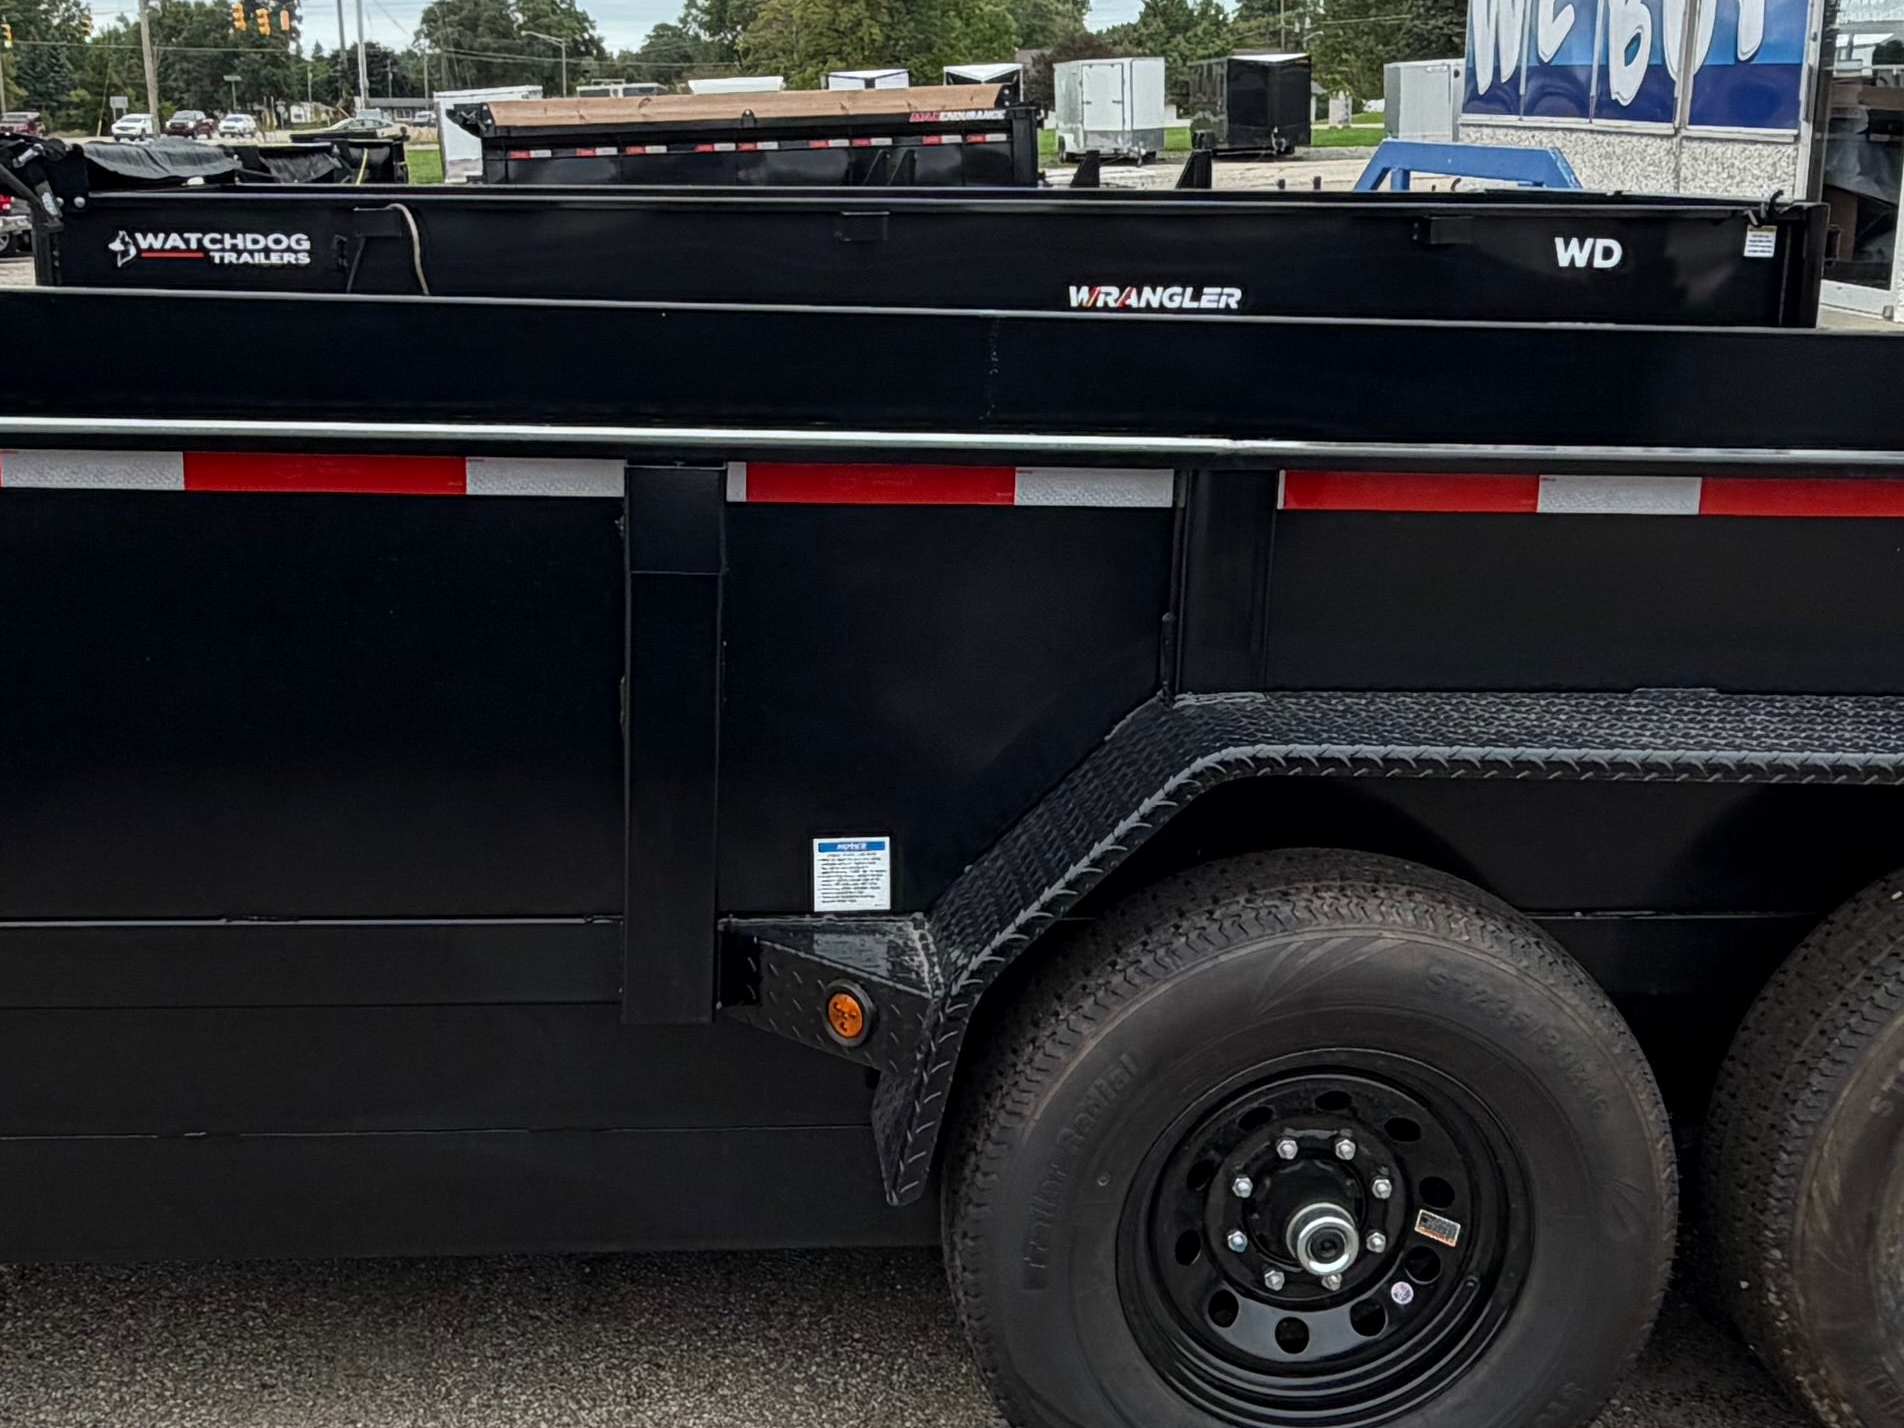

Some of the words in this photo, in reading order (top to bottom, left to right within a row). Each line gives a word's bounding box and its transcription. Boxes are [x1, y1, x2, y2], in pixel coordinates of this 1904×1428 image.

[134, 232, 311, 250] WATCHDOG
[209, 251, 311, 265] TRAILERS
[1554, 236, 1623, 268] WD
[1069, 285, 1243, 309] WRANGLER
